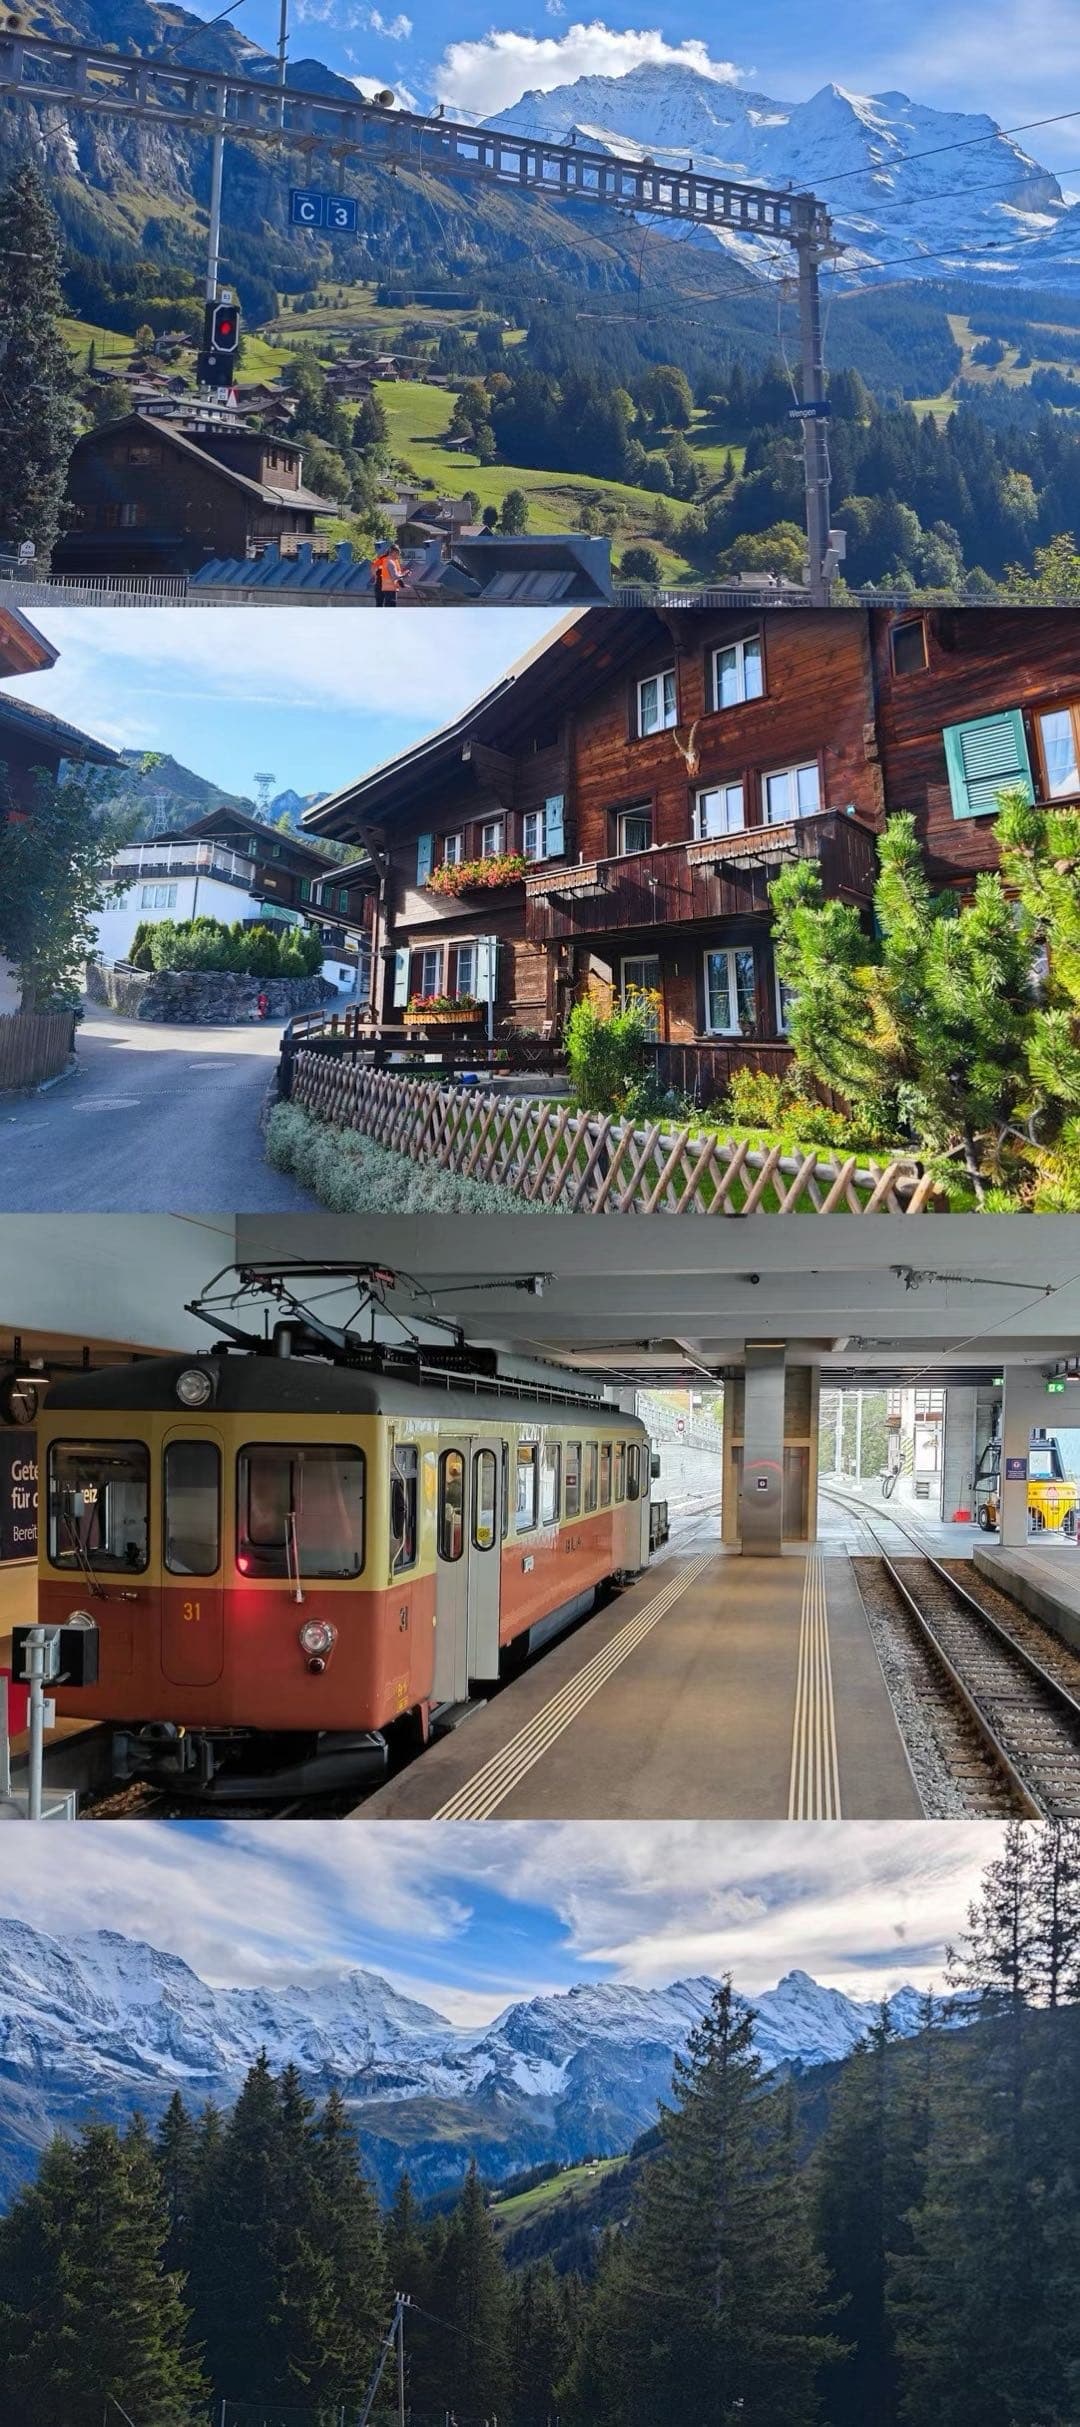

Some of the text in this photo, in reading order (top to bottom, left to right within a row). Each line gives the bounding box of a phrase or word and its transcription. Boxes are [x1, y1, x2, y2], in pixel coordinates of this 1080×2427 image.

[300, 202, 315, 220] C
[335, 208, 348, 226] 3
[11, 1486, 31, 1510] für
[183, 1602, 200, 1621] 31
